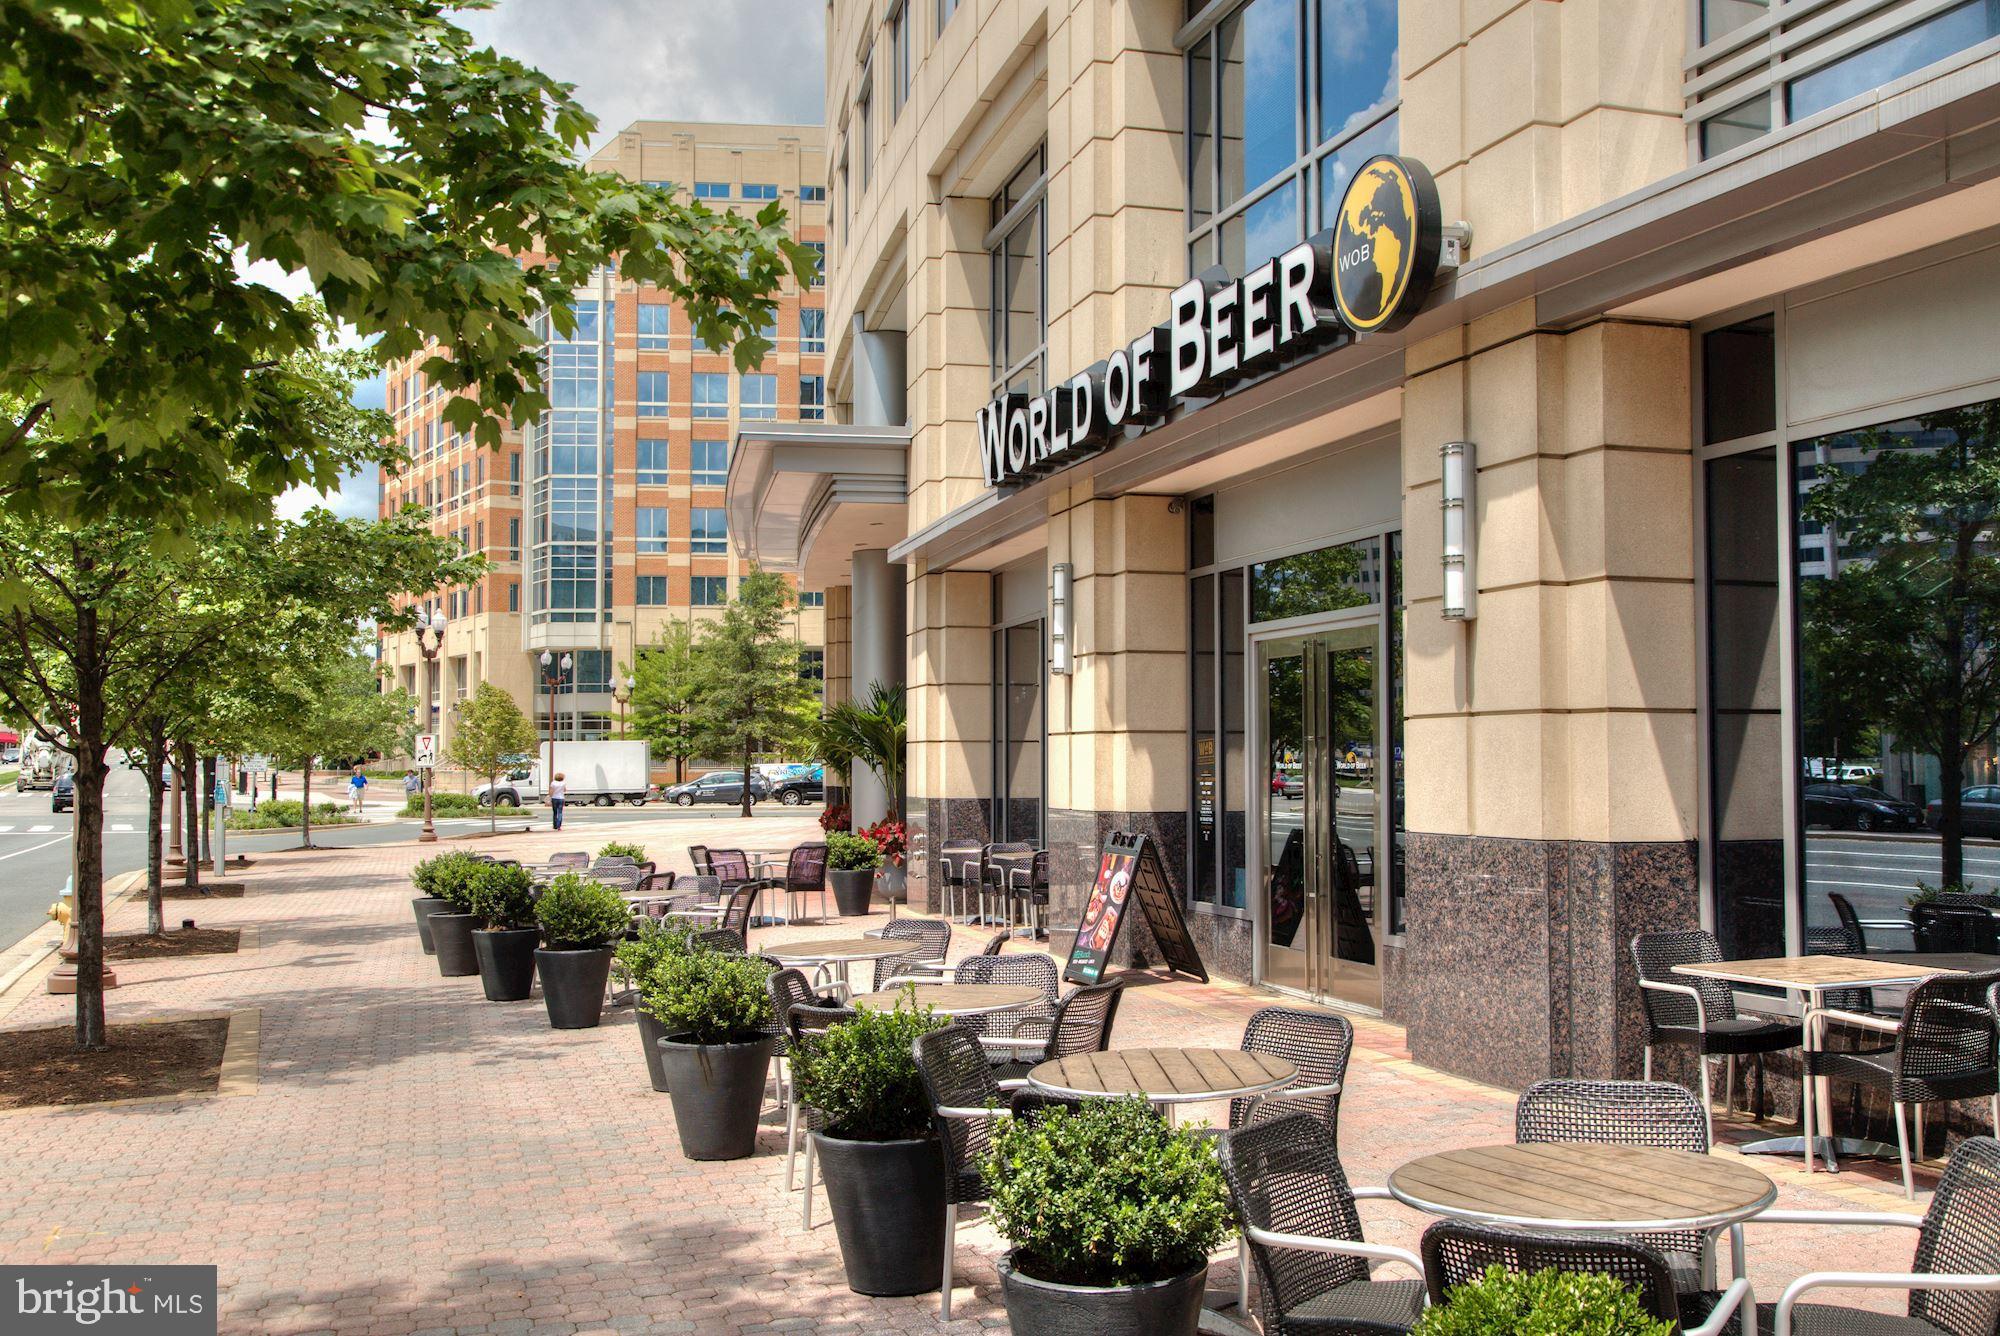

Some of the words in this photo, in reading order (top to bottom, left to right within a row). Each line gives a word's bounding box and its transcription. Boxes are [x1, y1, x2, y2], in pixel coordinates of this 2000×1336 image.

[1339, 243, 1370, 273] WOB
[976, 371, 1092, 488] WORLD
[1104, 327, 1156, 426] OF
[1169, 241, 1318, 397] BEER
